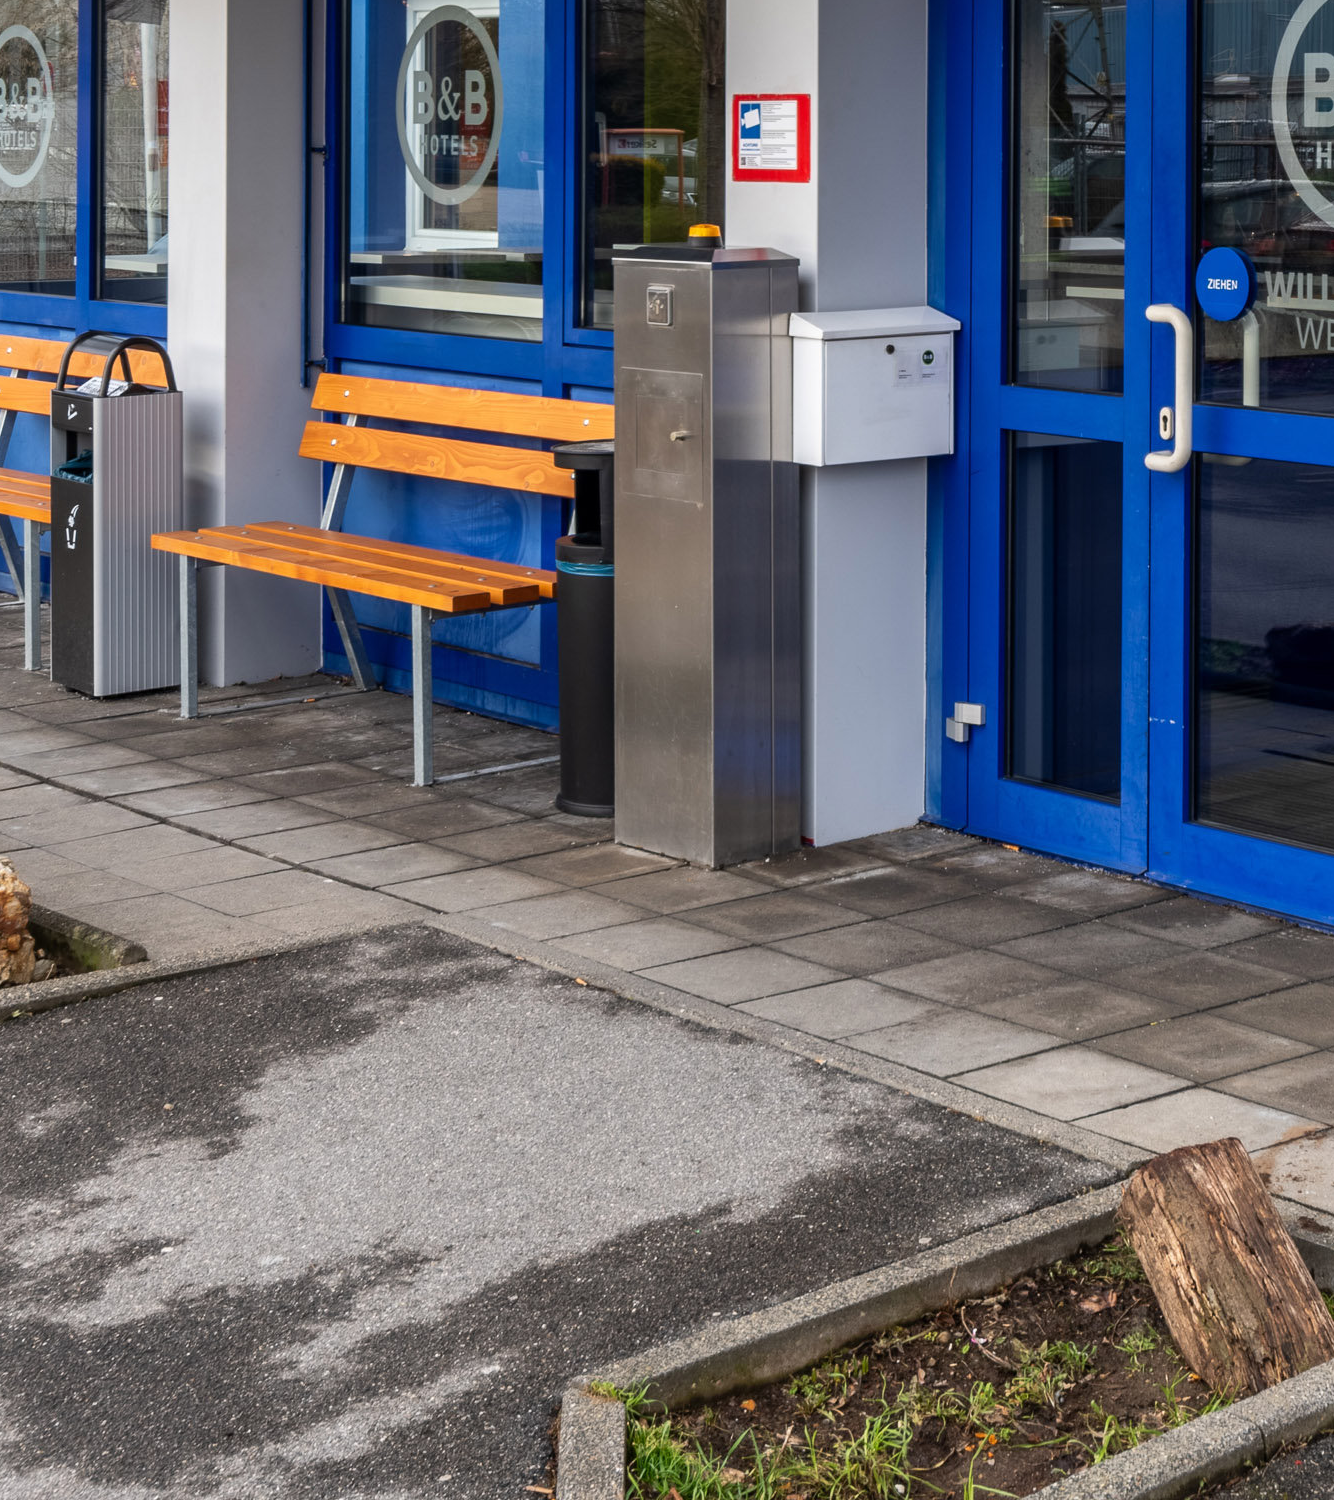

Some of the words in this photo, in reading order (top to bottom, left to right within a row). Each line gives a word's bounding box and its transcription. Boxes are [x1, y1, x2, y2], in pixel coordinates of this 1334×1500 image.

[413, 69, 488, 125] B&B
[419, 134, 478, 156] HOTELS
[1207, 278, 1238, 290] ZIEHEN
